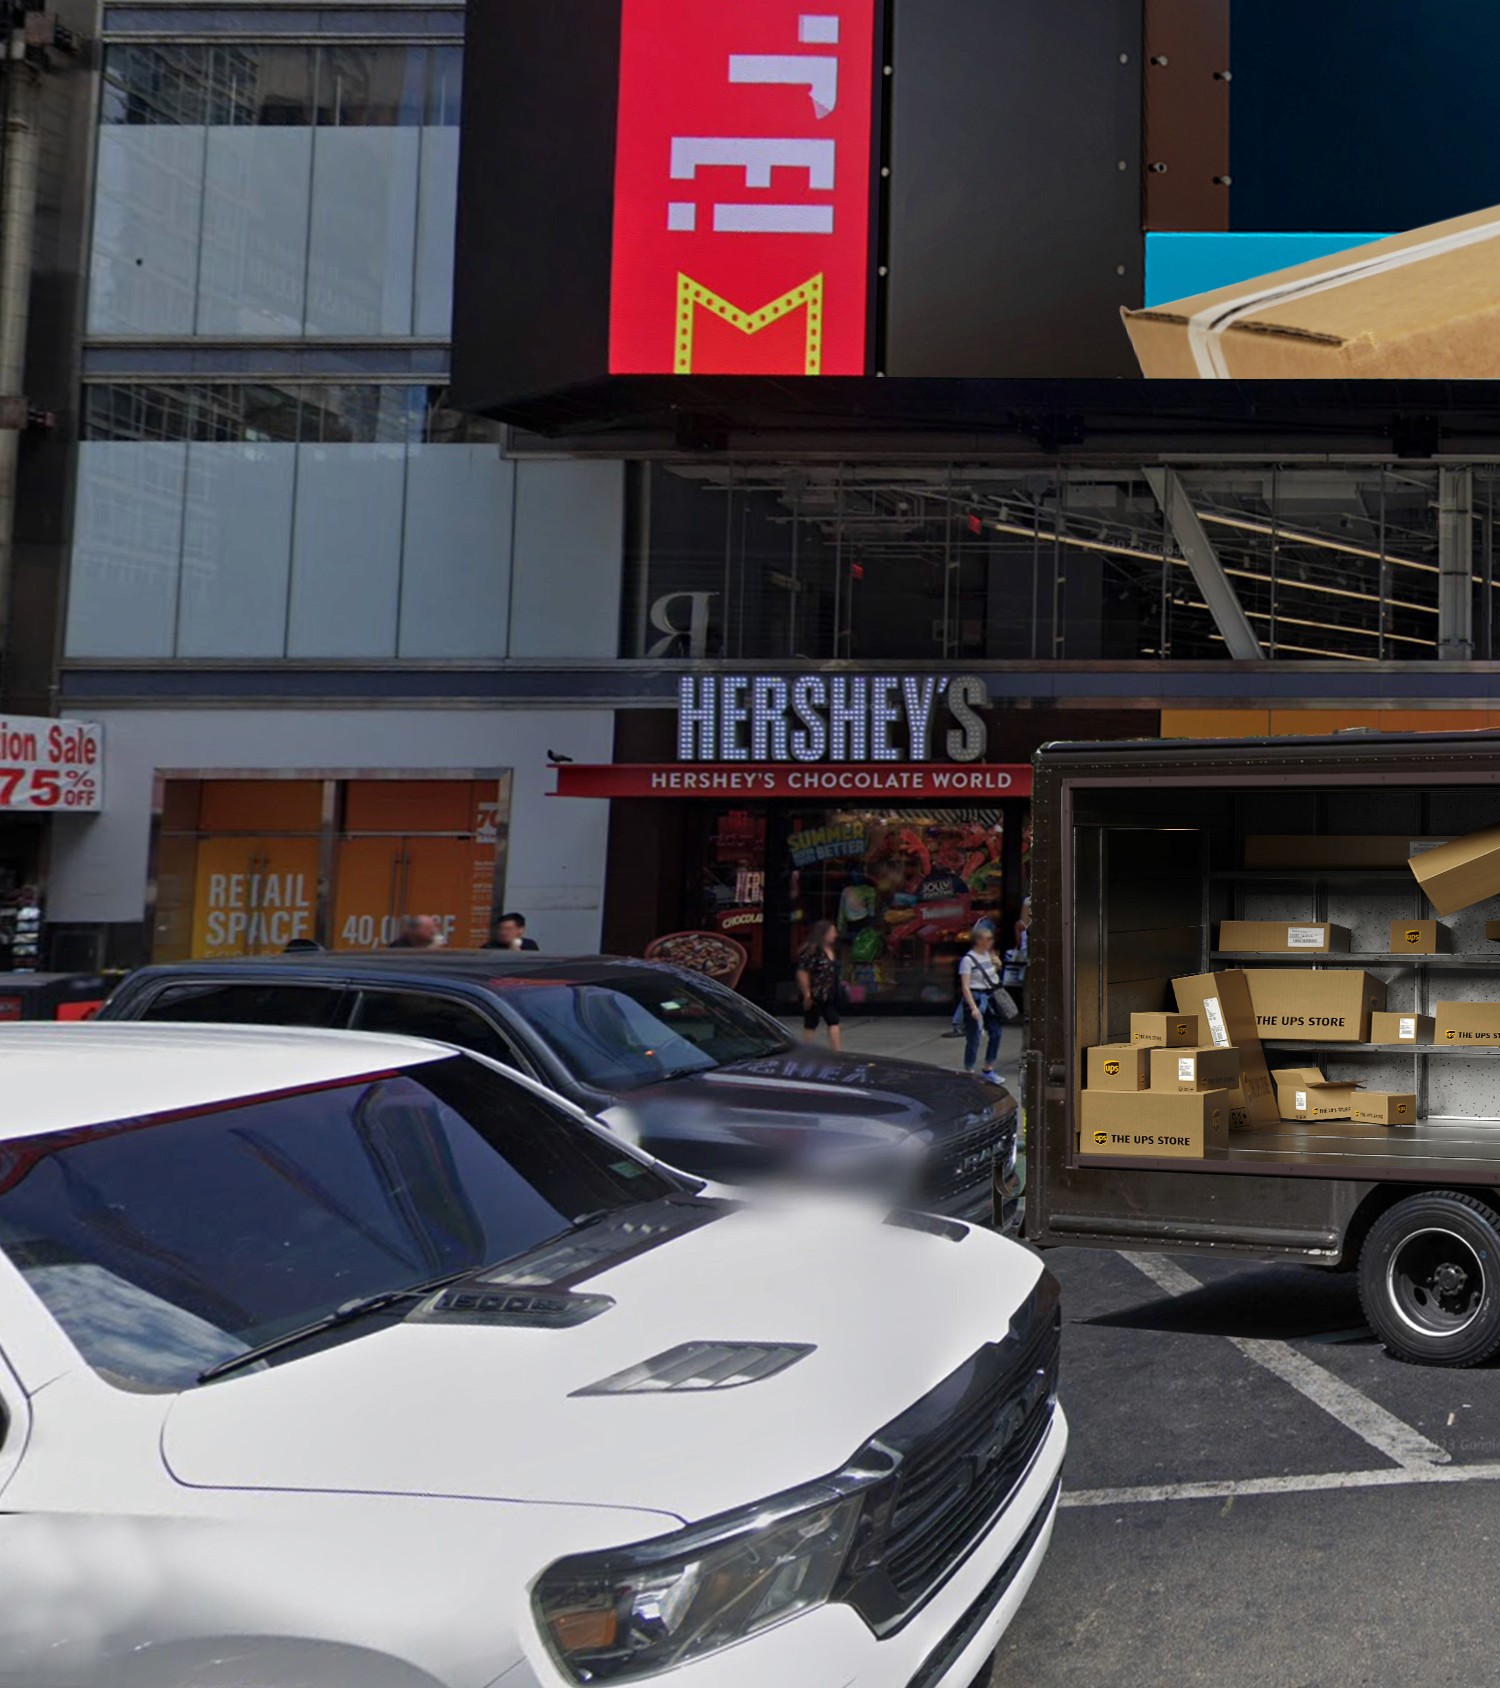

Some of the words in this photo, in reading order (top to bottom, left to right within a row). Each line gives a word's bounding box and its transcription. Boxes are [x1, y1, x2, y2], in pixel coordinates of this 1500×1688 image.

[677, 675, 988, 762] HERSHEY'S
[0, 722, 37, 761] ion
[48, 725, 97, 765] Sale
[0, 767, 62, 807] 75
[652, 772, 776, 789] HERSHEY'S
[787, 772, 924, 789] CHOCOLATE
[932, 772, 1013, 789] WORLD
[64, 790, 96, 806] OFF
[787, 820, 867, 852] SUMMER
[816, 839, 866, 860] BETTER
[208, 873, 310, 908] RETAIL
[205, 910, 310, 947] SPACE
[341, 915, 410, 949] 40,0
[721, 911, 764, 930] CHOCOLA
[1256, 1015, 1277, 1026] THE
[1281, 1016, 1304, 1026] UPS
[1308, 1016, 1346, 1027] STORE
[1458, 1031, 1473, 1039] THE
[1112, 1134, 1130, 1144] THE
[1134, 1135, 1154, 1145] UPS
[1157, 1136, 1190, 1146] STORE
